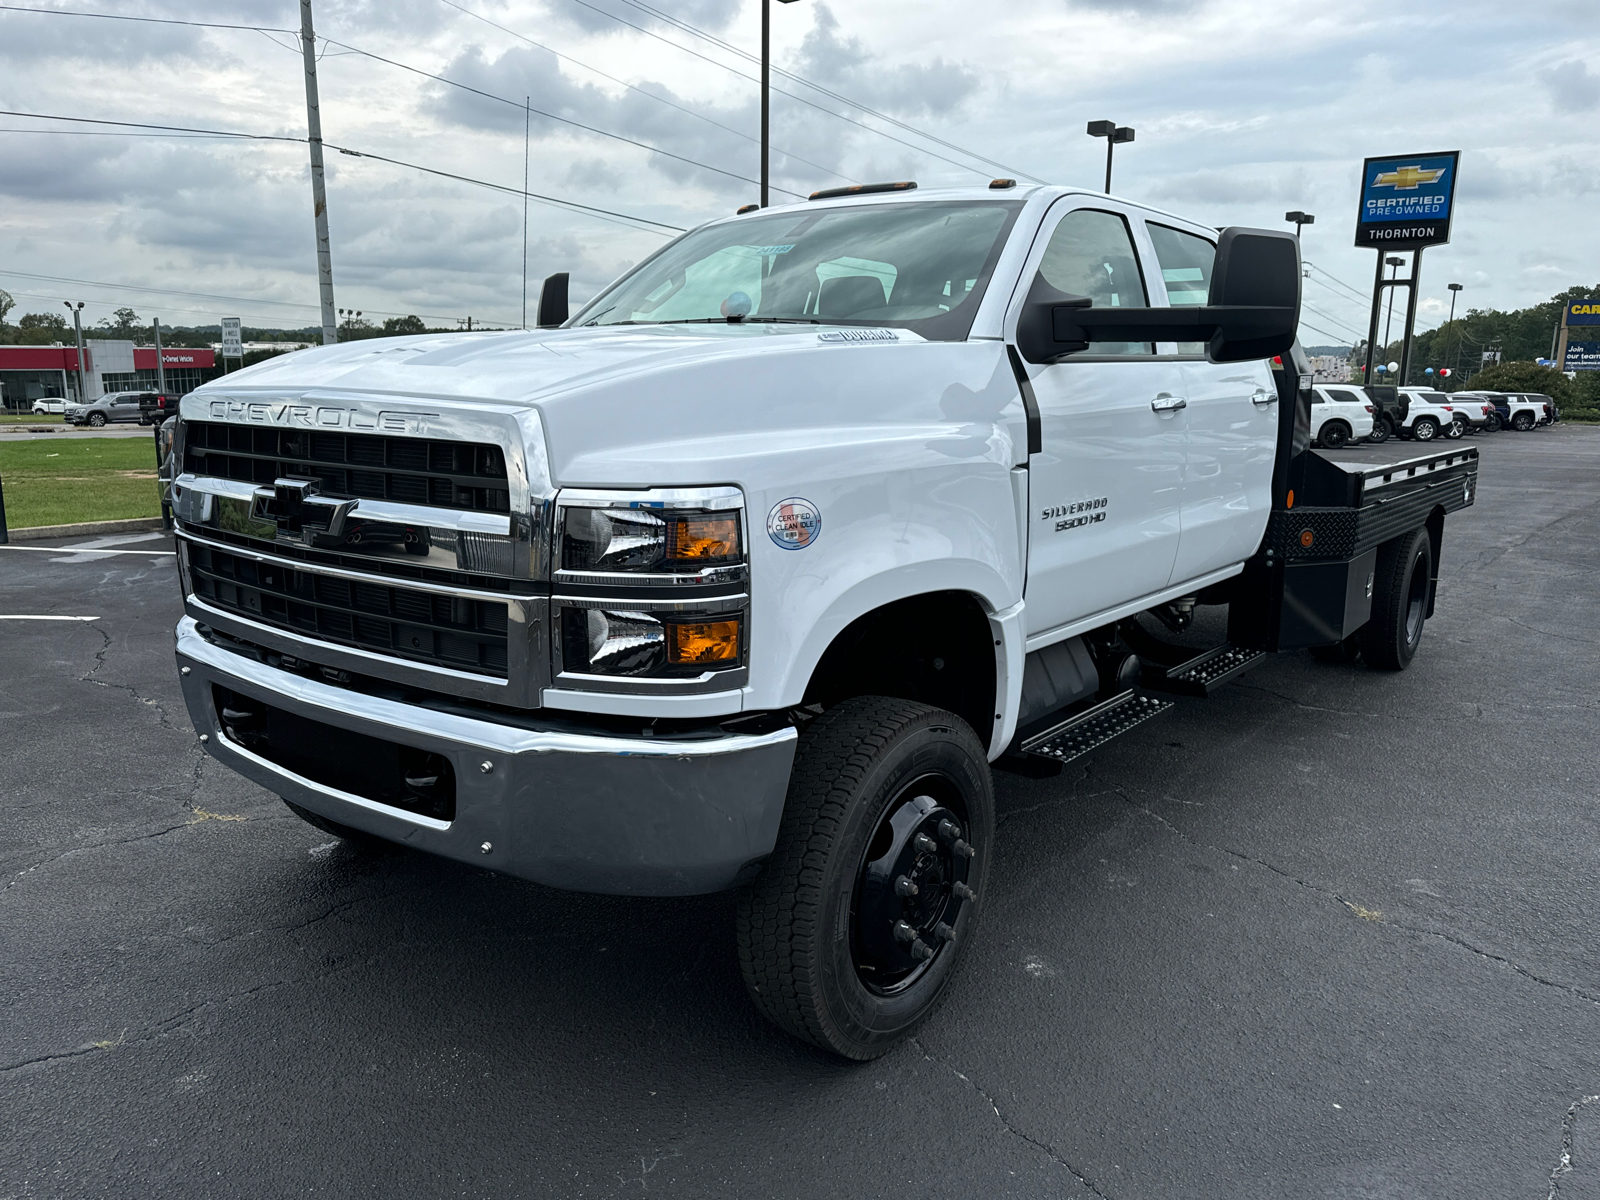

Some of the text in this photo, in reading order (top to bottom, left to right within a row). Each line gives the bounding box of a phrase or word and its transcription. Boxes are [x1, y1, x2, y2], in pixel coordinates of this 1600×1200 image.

[1366, 195, 1445, 208] CERTIFIED
[1369, 204, 1440, 216] PRE-OWNED
[1369, 227, 1435, 240] THORNTON
[1571, 304, 1600, 315] CAR
[1568, 345, 1584, 353] Join
[209, 401, 441, 434] CHEVROLET
[1041, 497, 1108, 521] SILVERADO
[777, 512, 811, 523] CERTIFIED
[775, 520, 814, 531] CLEAN IDLE
